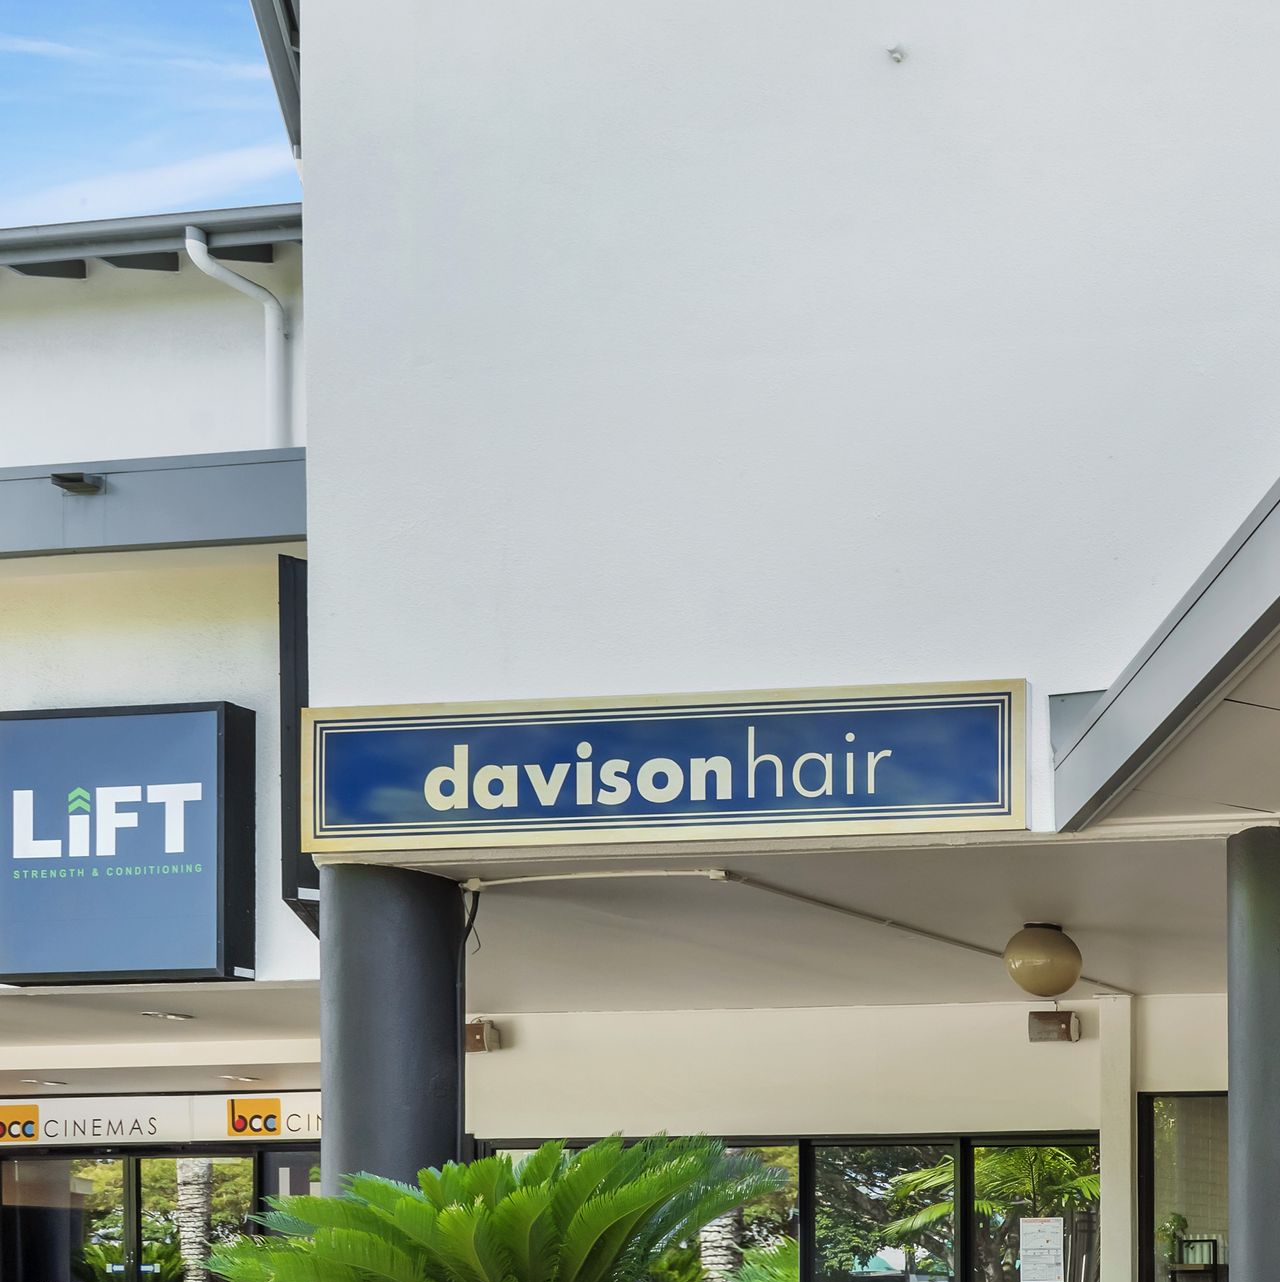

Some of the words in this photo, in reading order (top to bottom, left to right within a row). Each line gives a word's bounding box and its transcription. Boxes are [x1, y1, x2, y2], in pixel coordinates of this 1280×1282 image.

[13, 868, 85, 879] STRENGTH
[91, 868, 99, 877] &
[106, 863, 203, 877] CONDITIONING
[230, 1098, 277, 1133] bcc
[43, 1117, 158, 1138] CINEMAS
